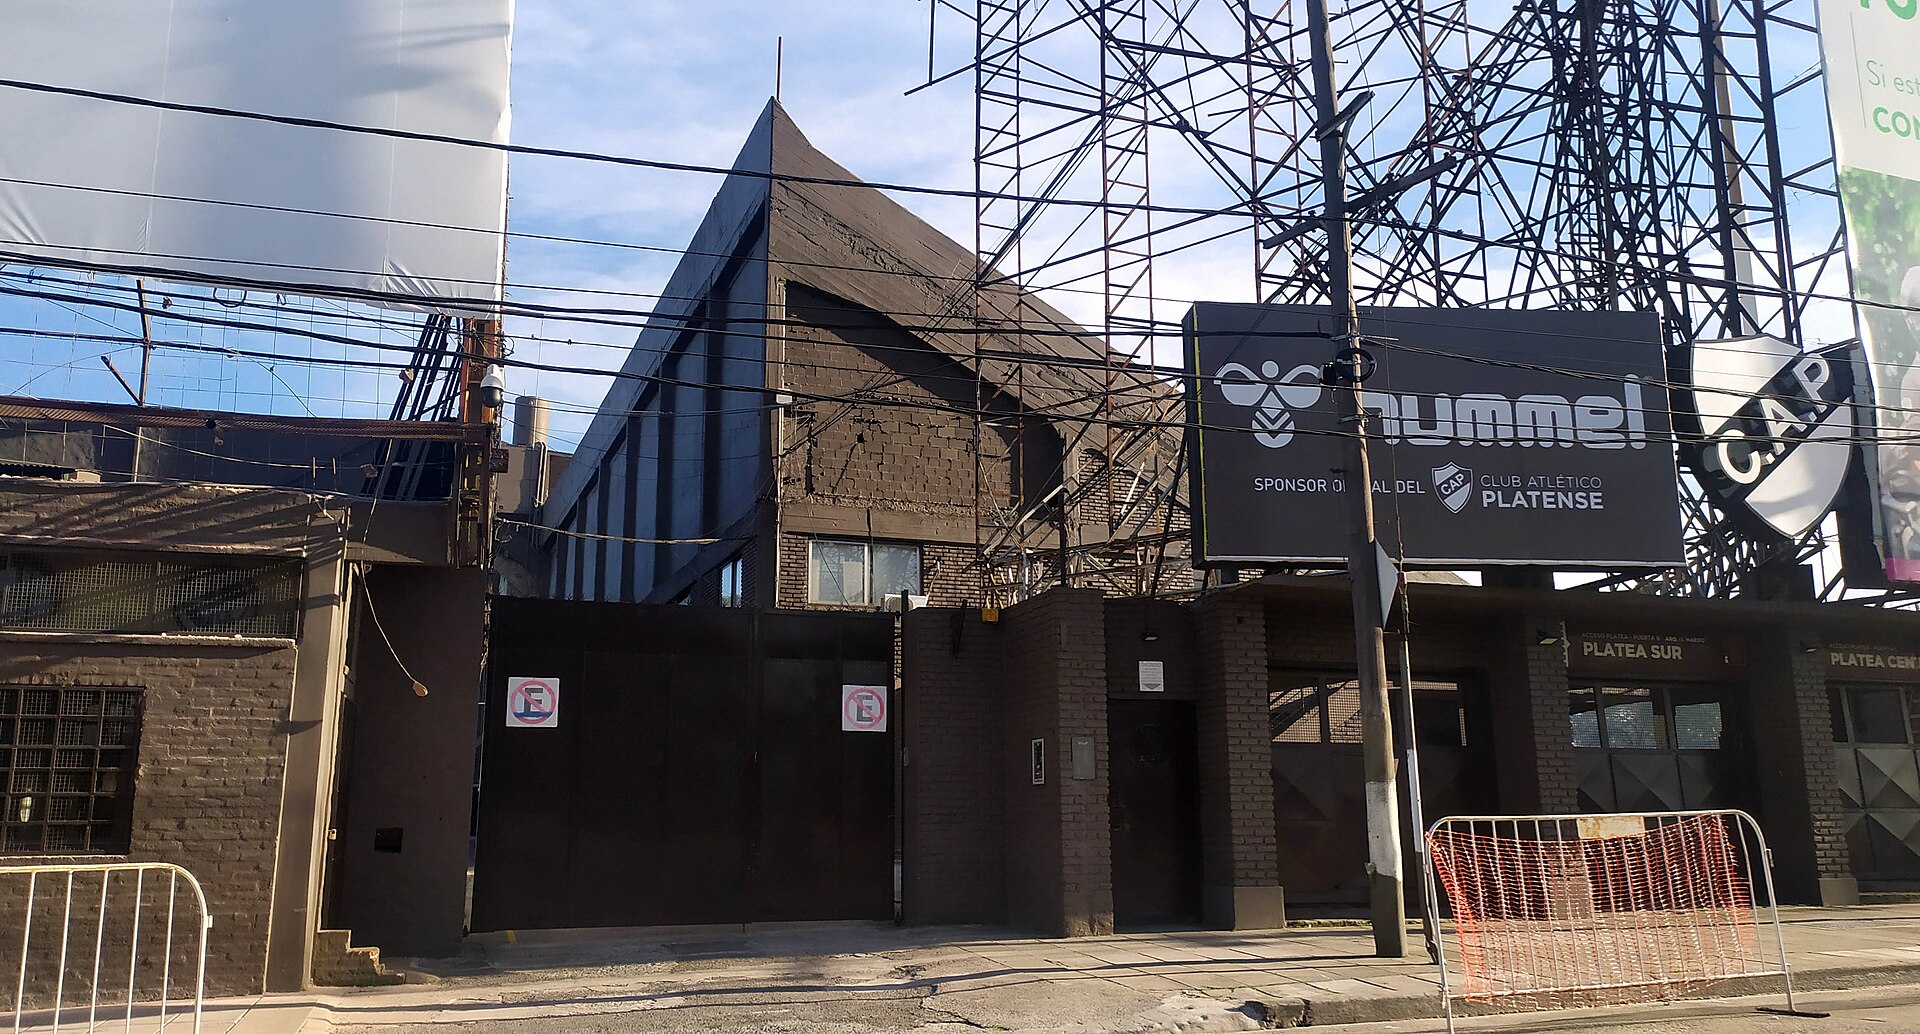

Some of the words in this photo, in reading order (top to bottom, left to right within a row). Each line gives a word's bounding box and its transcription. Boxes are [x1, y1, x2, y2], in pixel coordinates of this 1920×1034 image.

[1866, 59, 1886, 88] Si
[1254, 477, 1328, 492] SPONSOR
[1396, 480, 1426, 494] DEL
[1440, 472, 1466, 496] CAP
[1480, 474, 1522, 488] CLUB
[1527, 473, 1602, 489] ATLÉTICO
[1481, 490, 1604, 510] PLATENSE
[1583, 641, 1648, 659] PLATEA
[1650, 644, 1683, 660] SUR
[1830, 652, 1886, 668] PLATEA
[1887, 655, 1920, 670] CENT
